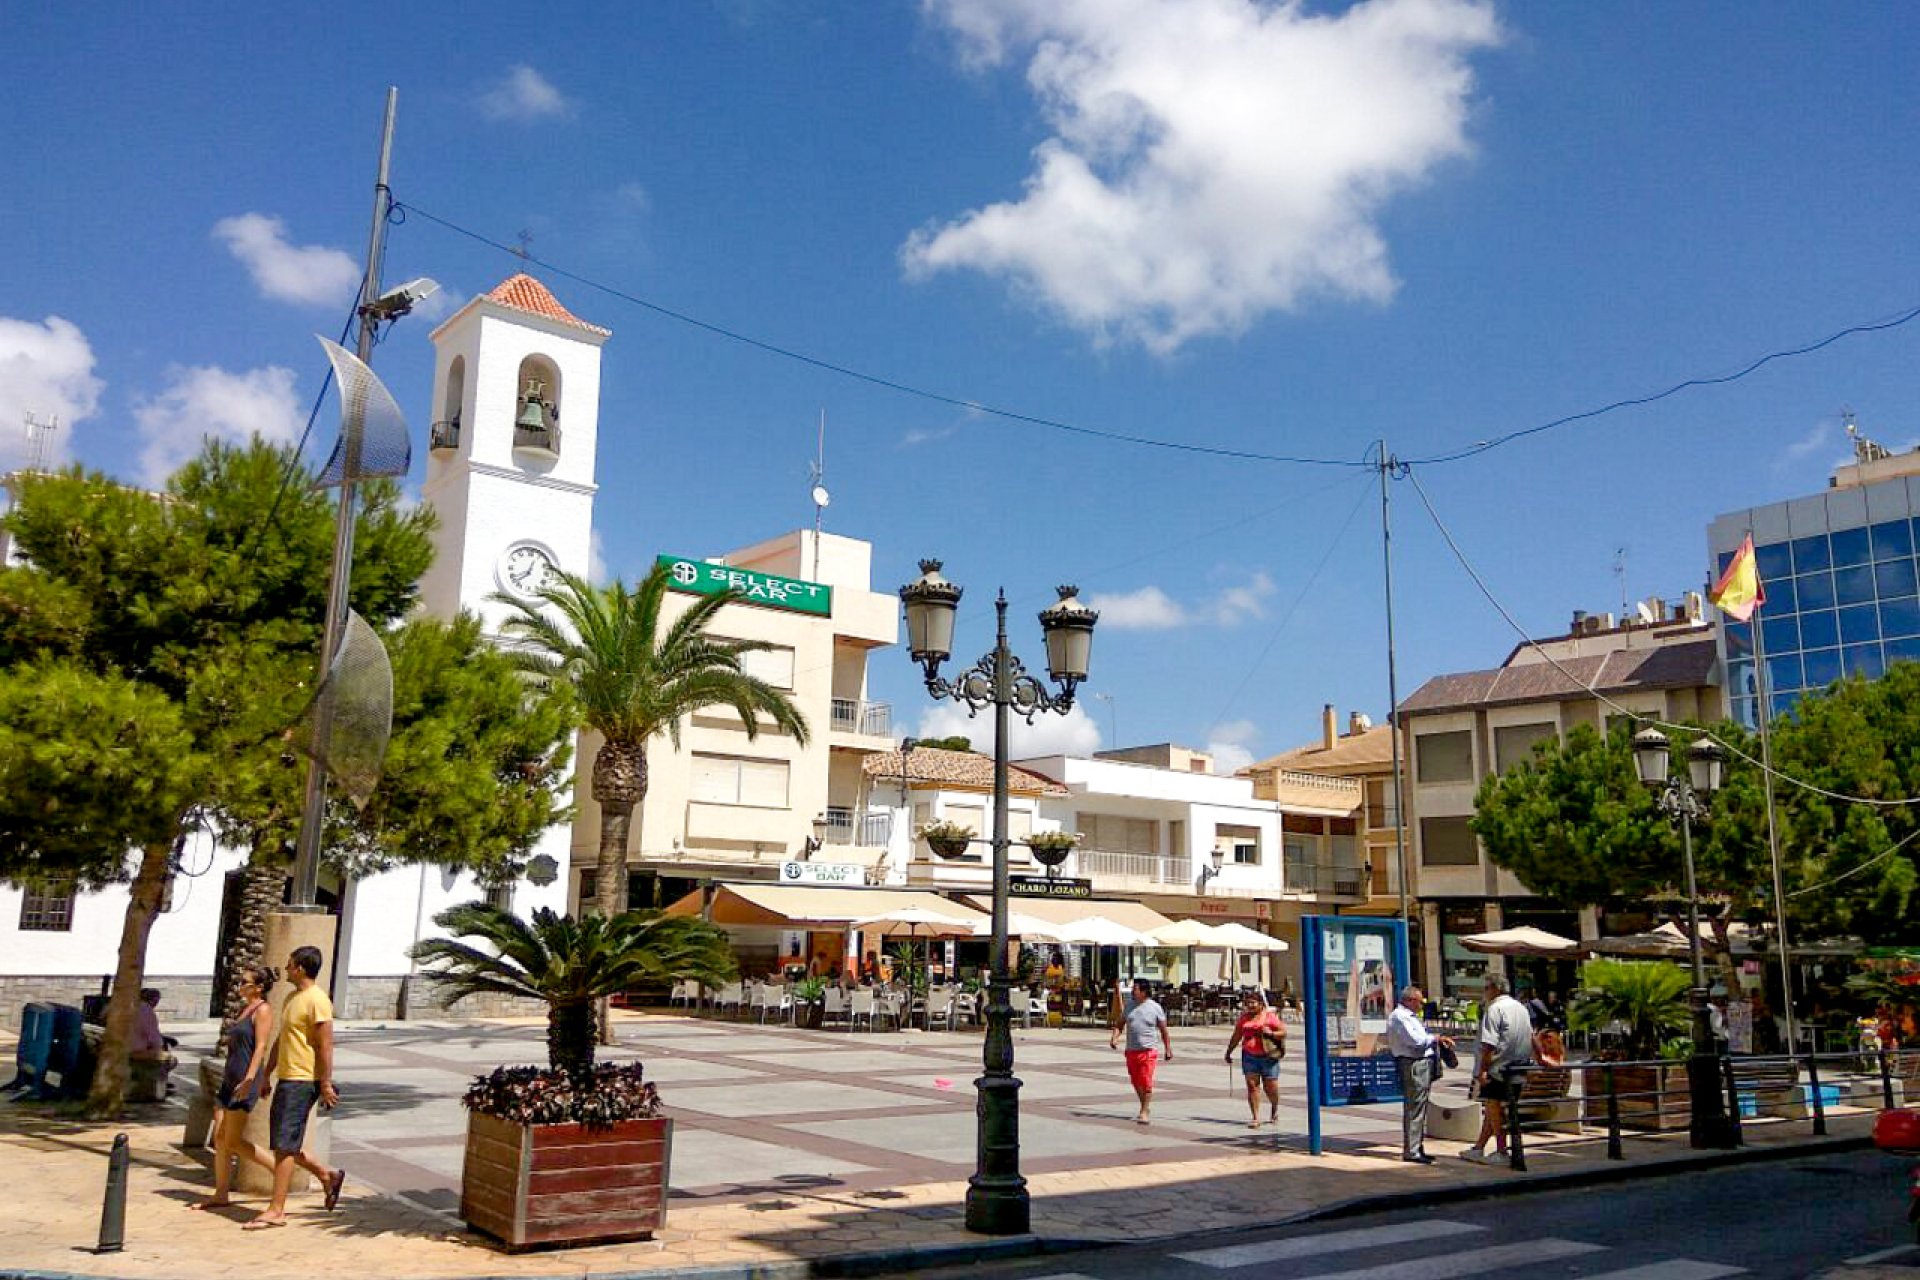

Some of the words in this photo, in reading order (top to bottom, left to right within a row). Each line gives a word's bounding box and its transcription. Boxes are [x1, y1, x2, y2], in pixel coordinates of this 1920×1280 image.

[710, 569, 822, 597] SELECT
[729, 582, 787, 601] BAR
[804, 864, 858, 875] SELECT
[1012, 883, 1047, 893] CHARO
[1049, 886, 1089, 896] LOZANO
